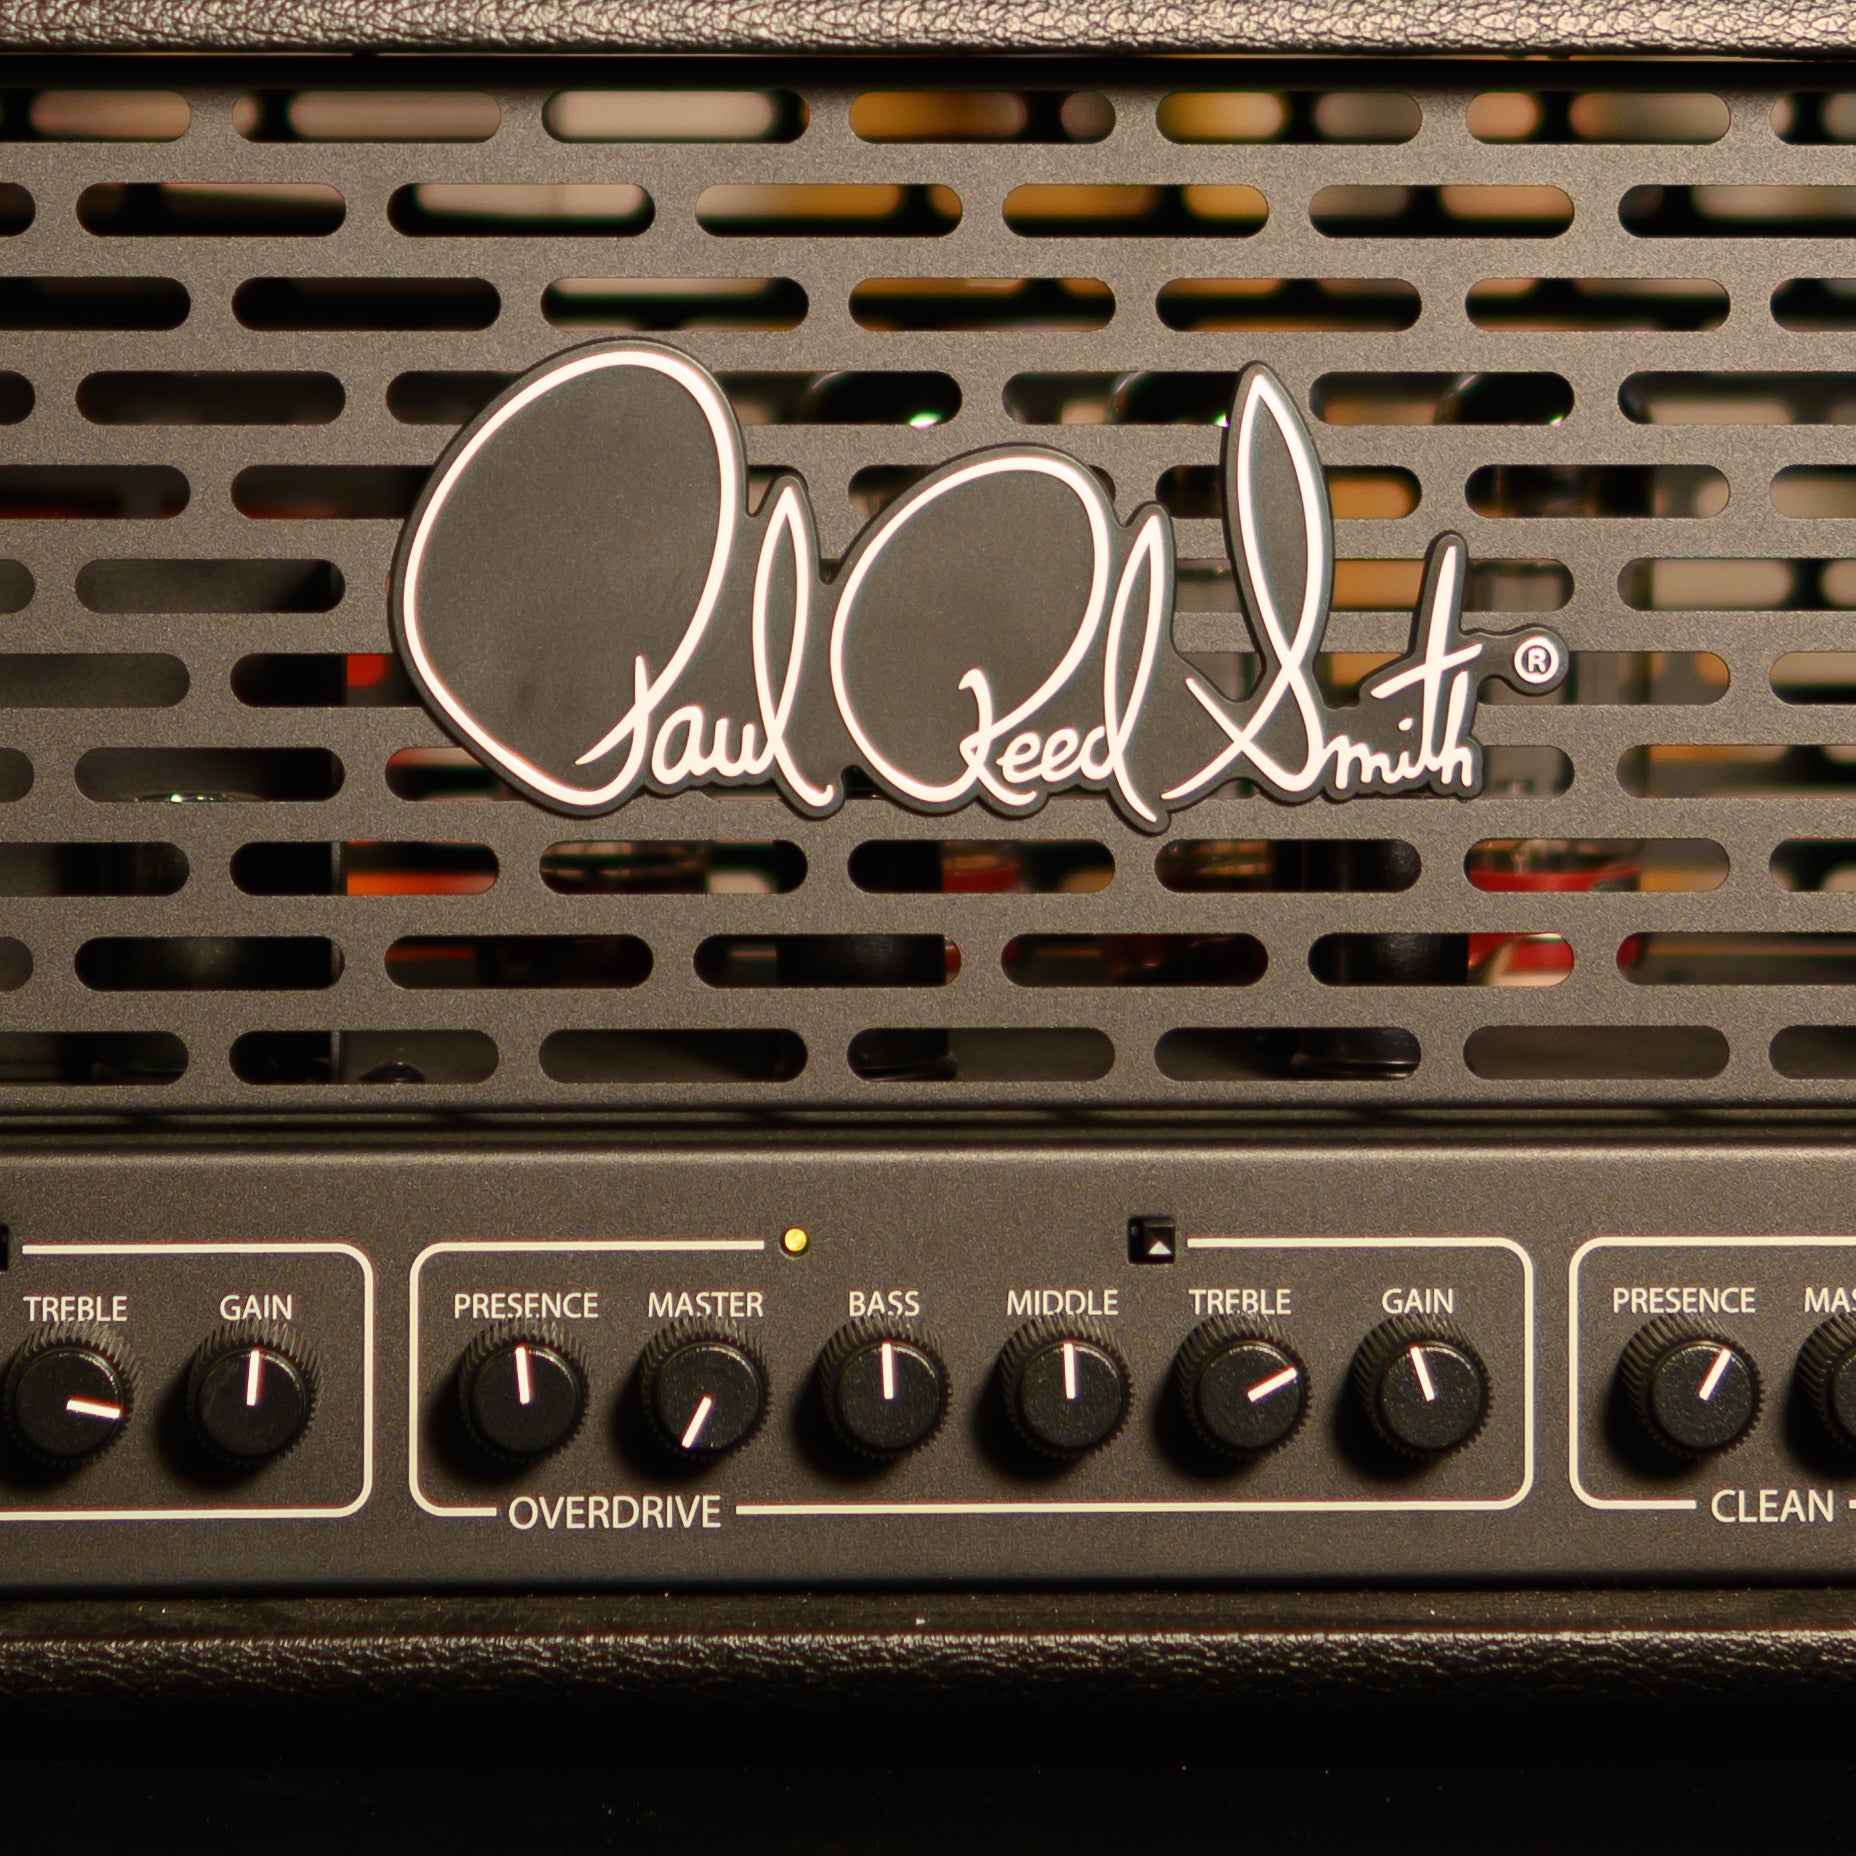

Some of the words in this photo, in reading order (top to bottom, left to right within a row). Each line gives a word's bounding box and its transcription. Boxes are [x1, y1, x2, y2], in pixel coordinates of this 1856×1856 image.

[402, 350, 836, 808] Paul
[829, 456, 1166, 824] Reed
[1160, 373, 1484, 800] Smith
[21, 1294, 129, 1324] TREBLE
[218, 1293, 293, 1322] GAIN
[453, 1291, 600, 1321] PRESENCE
[647, 1290, 765, 1319] MASTER
[848, 1289, 921, 1318] BASS
[1005, 1288, 1120, 1318] MIDDLE
[1187, 1287, 1293, 1317] TREBLE
[1380, 1286, 1455, 1316] GAIN
[1612, 1285, 1757, 1315] PRESENCE
[507, 1493, 723, 1531] OVERDRIVE
[1710, 1488, 1835, 1524] CLEAN
